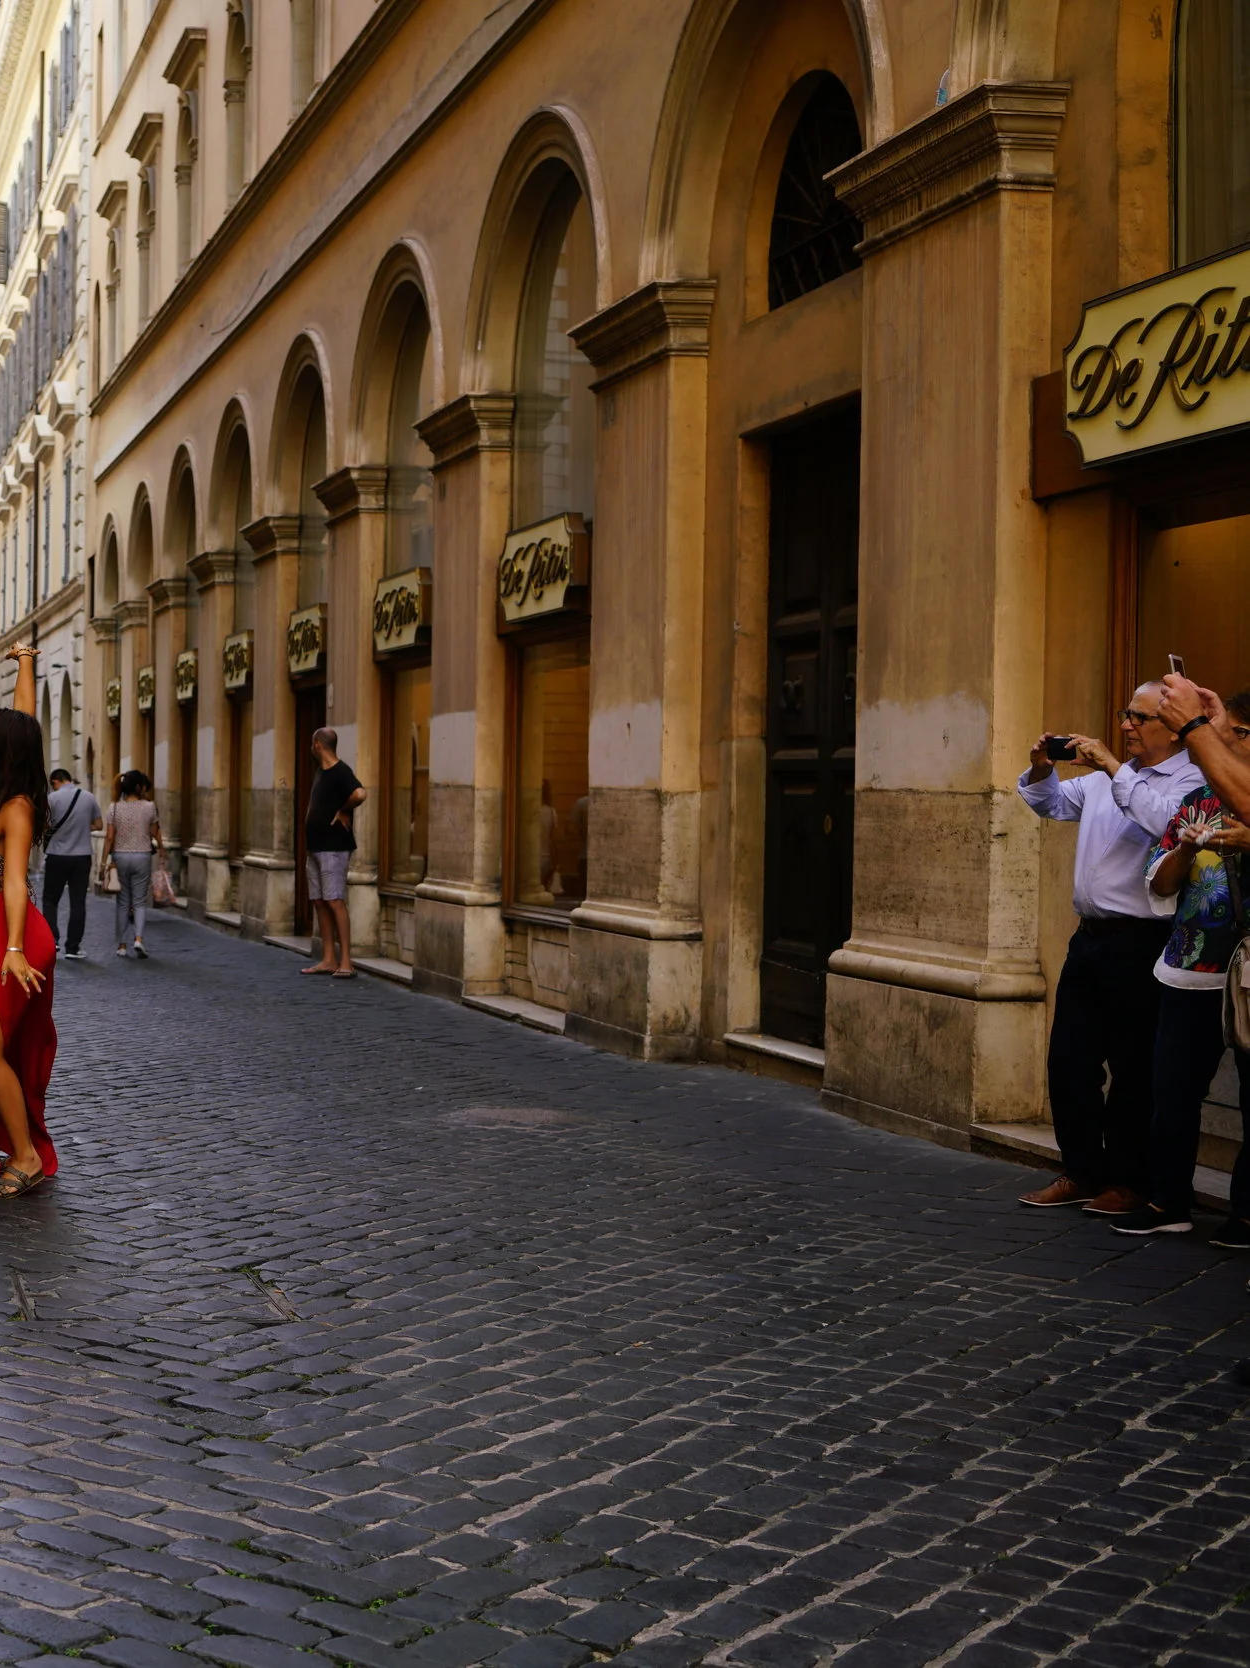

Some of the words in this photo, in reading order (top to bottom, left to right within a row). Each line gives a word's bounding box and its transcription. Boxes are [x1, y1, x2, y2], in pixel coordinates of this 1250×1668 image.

[1067, 317, 1145, 420] De
[1115, 286, 1250, 430] Rit
[500, 547, 525, 598] De
